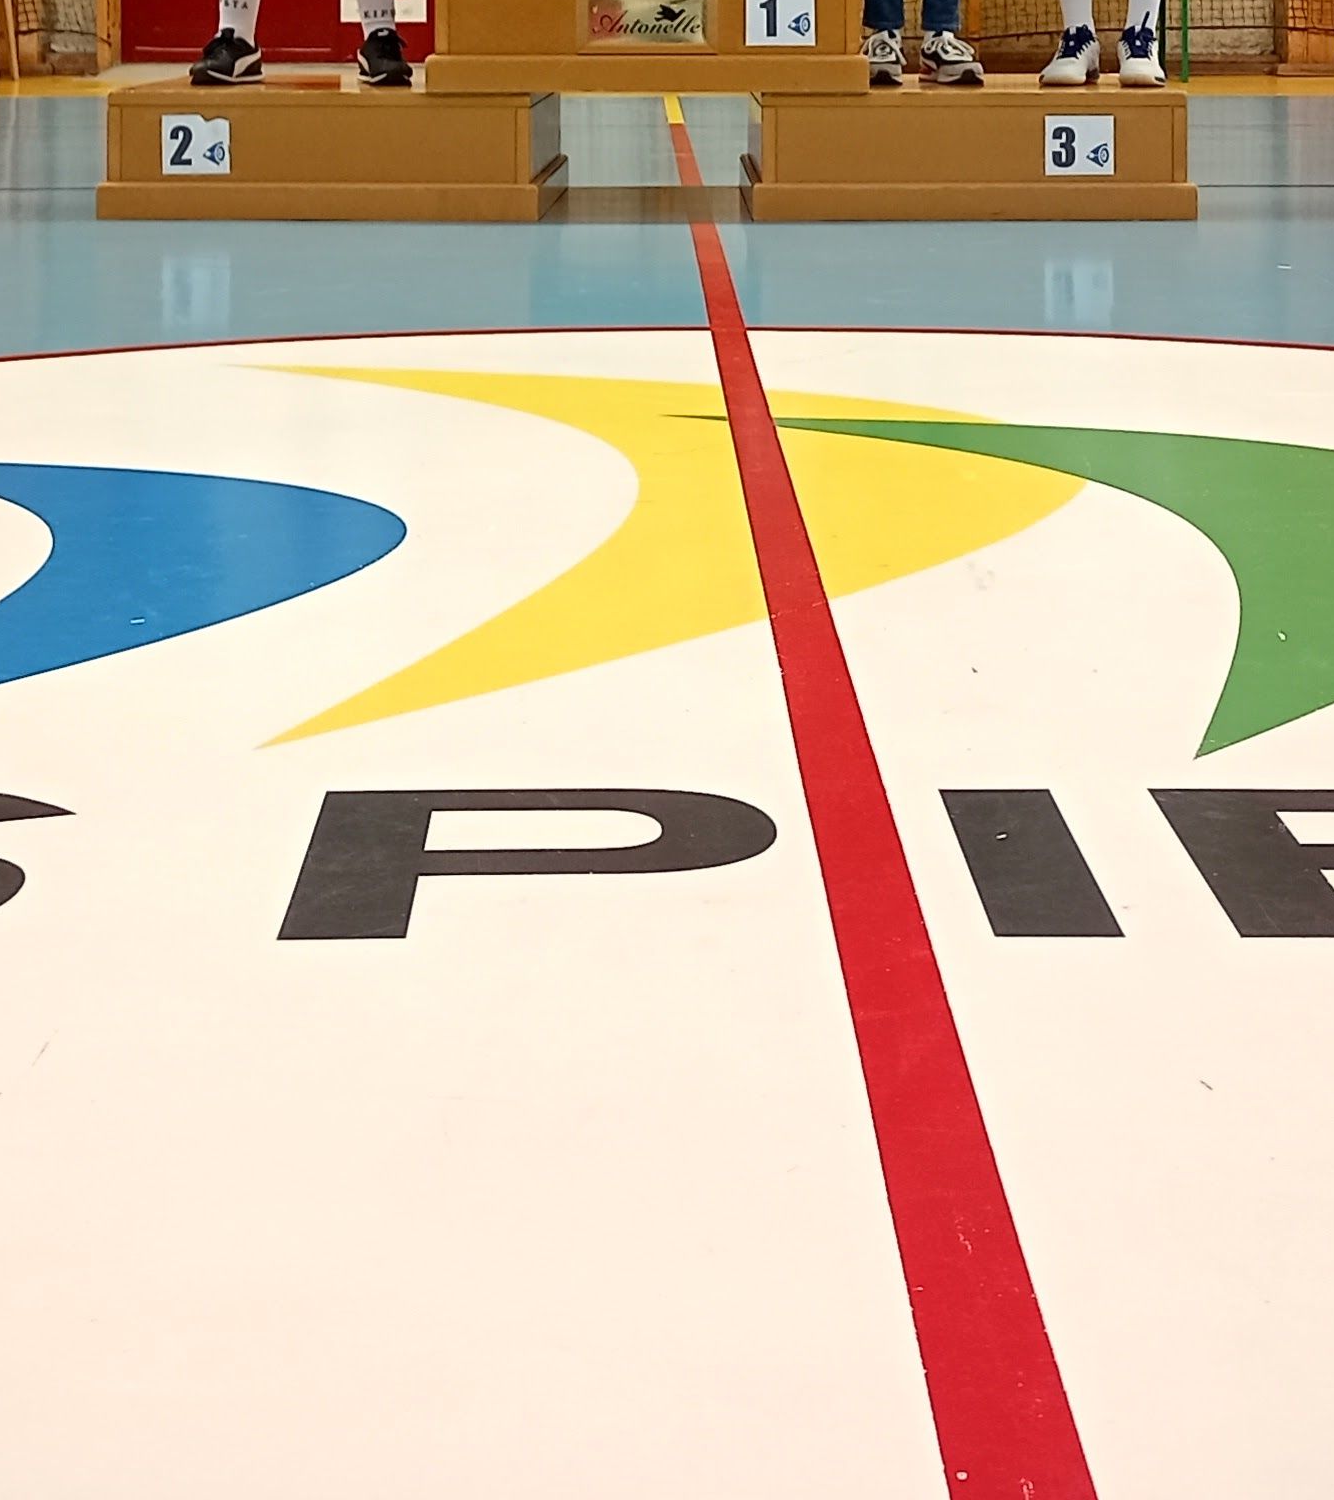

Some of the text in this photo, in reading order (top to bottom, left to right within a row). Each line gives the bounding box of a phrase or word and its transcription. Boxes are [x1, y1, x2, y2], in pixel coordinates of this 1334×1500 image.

[593, 9, 701, 35] Antonelle
[169, 125, 194, 167] 2
[1051, 126, 1076, 168] 3
